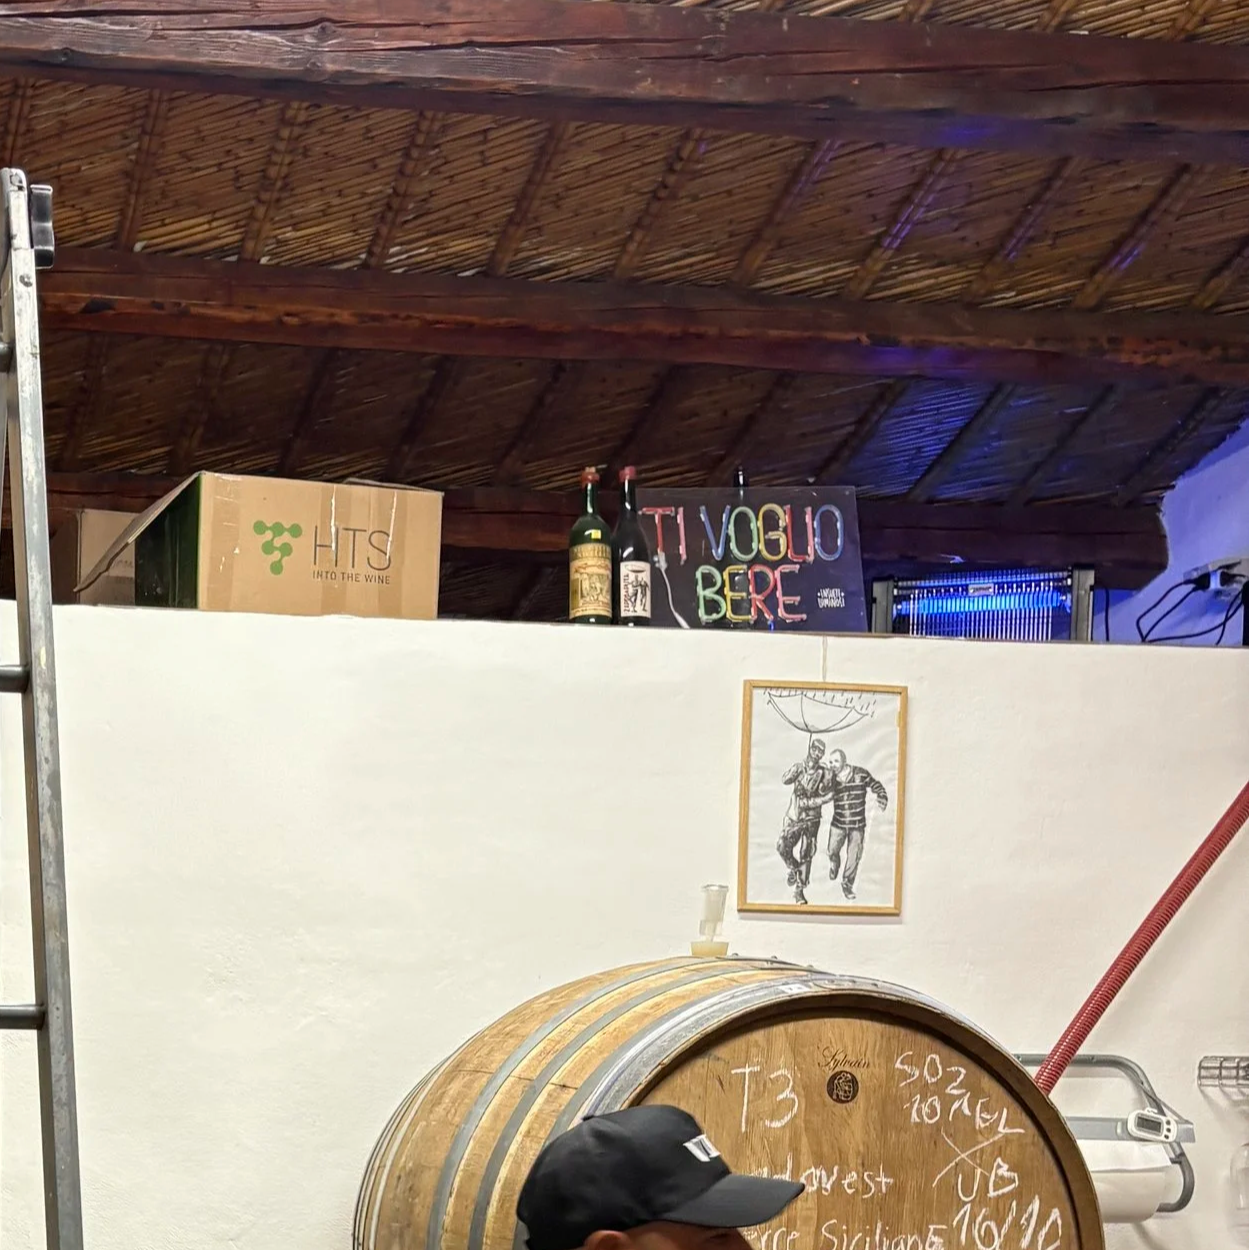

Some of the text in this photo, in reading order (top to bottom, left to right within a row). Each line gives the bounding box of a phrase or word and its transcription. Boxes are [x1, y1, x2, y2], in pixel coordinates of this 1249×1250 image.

[313, 524, 392, 571] HTS
[638, 503, 845, 565] TI VOGLIO
[312, 570, 391, 585] INTO THE WINE
[695, 564, 808, 624] BERE
[731, 1058, 800, 1133] T3
